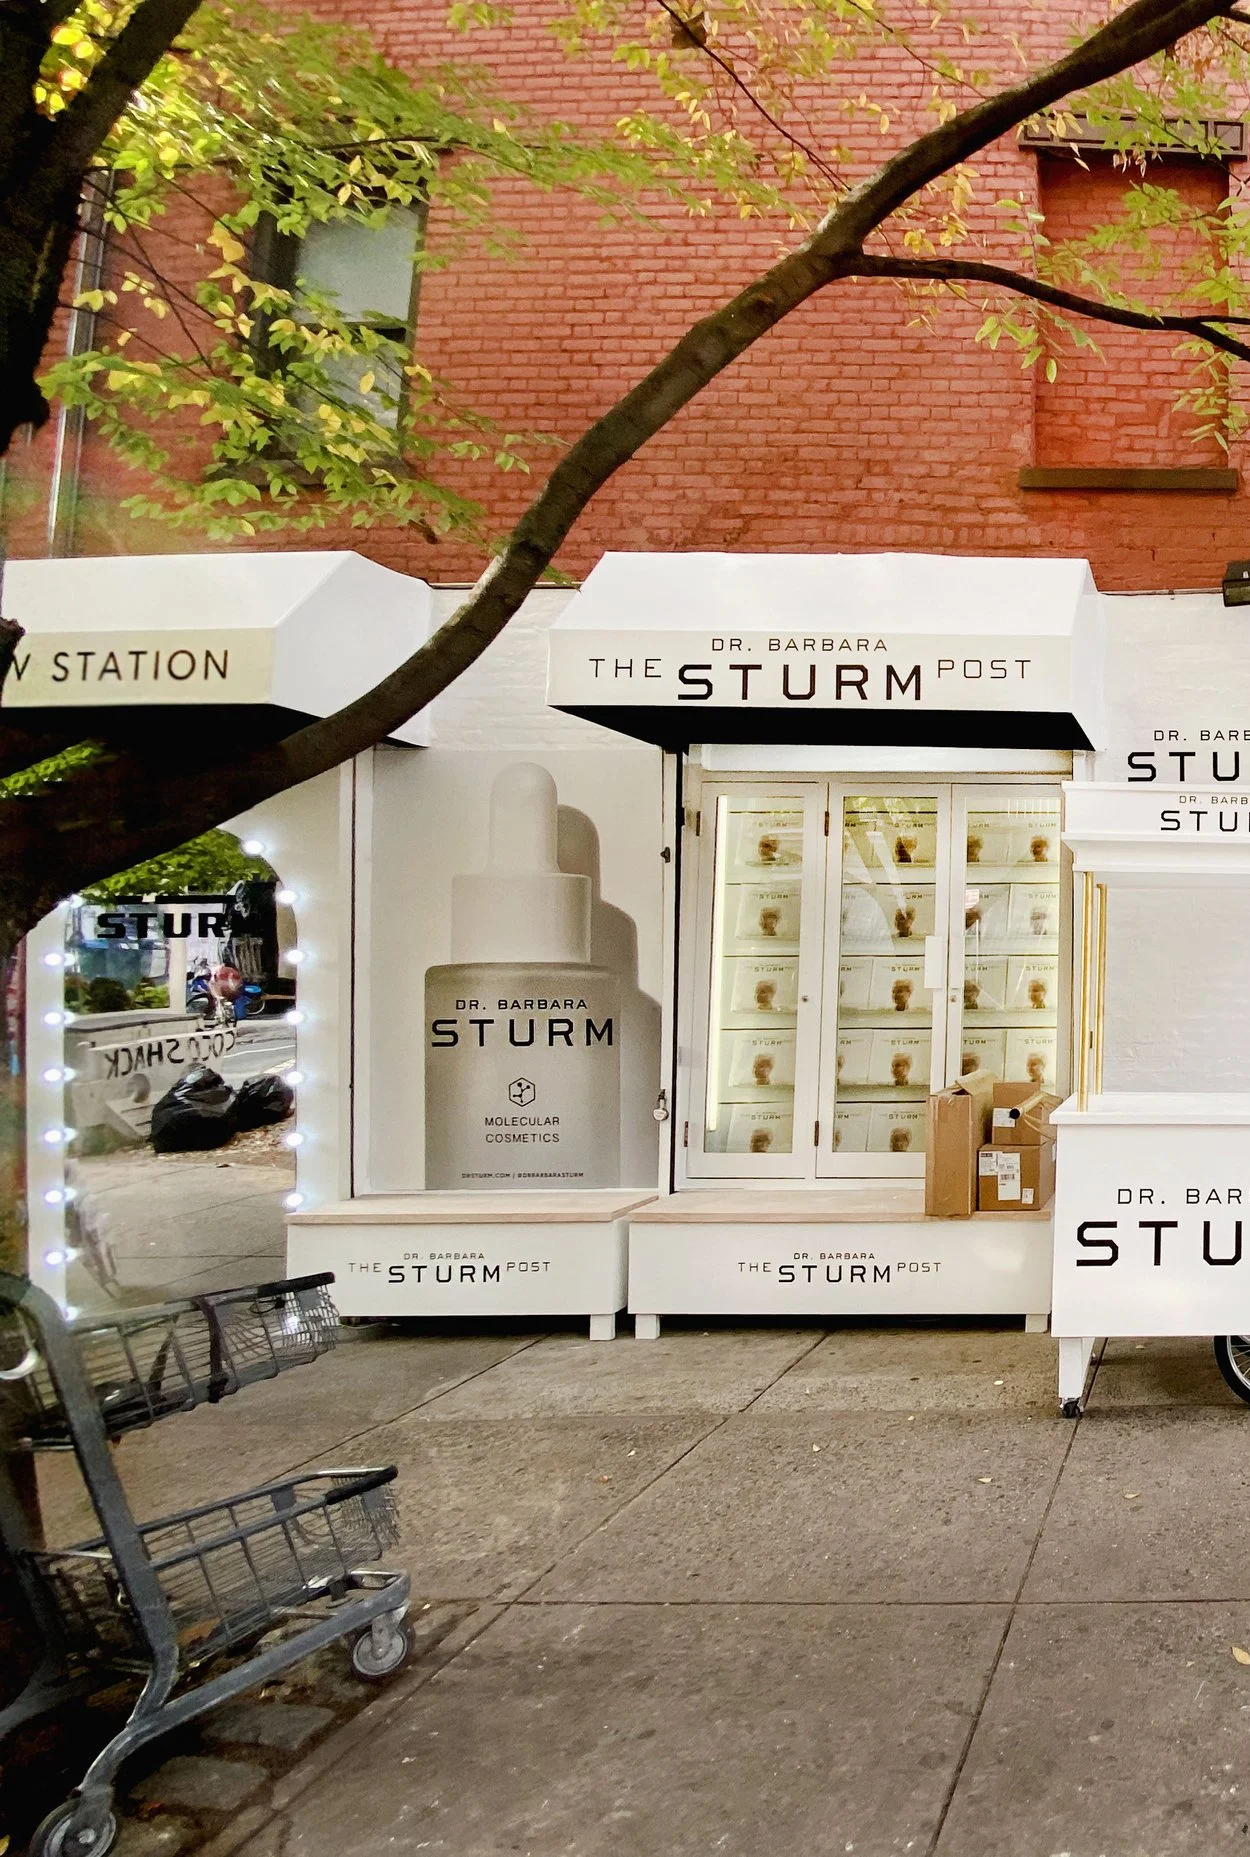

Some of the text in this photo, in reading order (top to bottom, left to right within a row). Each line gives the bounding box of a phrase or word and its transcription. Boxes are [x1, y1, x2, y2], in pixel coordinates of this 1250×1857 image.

[712, 639, 887, 651] DR. BARBARA
[52, 650, 228, 682] STATION
[589, 659, 1031, 700] THE STURM POST
[1154, 730, 1186, 741] DR.
[1180, 796, 1201, 804] DR.
[97, 912, 232, 938] STUR
[456, 999, 588, 1010] DR. BARBARA
[431, 1018, 614, 1047] STURM
[485, 1117, 559, 1126] MOLECULAR
[486, 1133, 559, 1143] COSMETICS
[1118, 1189, 1165, 1204] DR.
[349, 1262, 550, 1283] THE STURM POST
[738, 1263, 941, 1283] THE STURM POST
